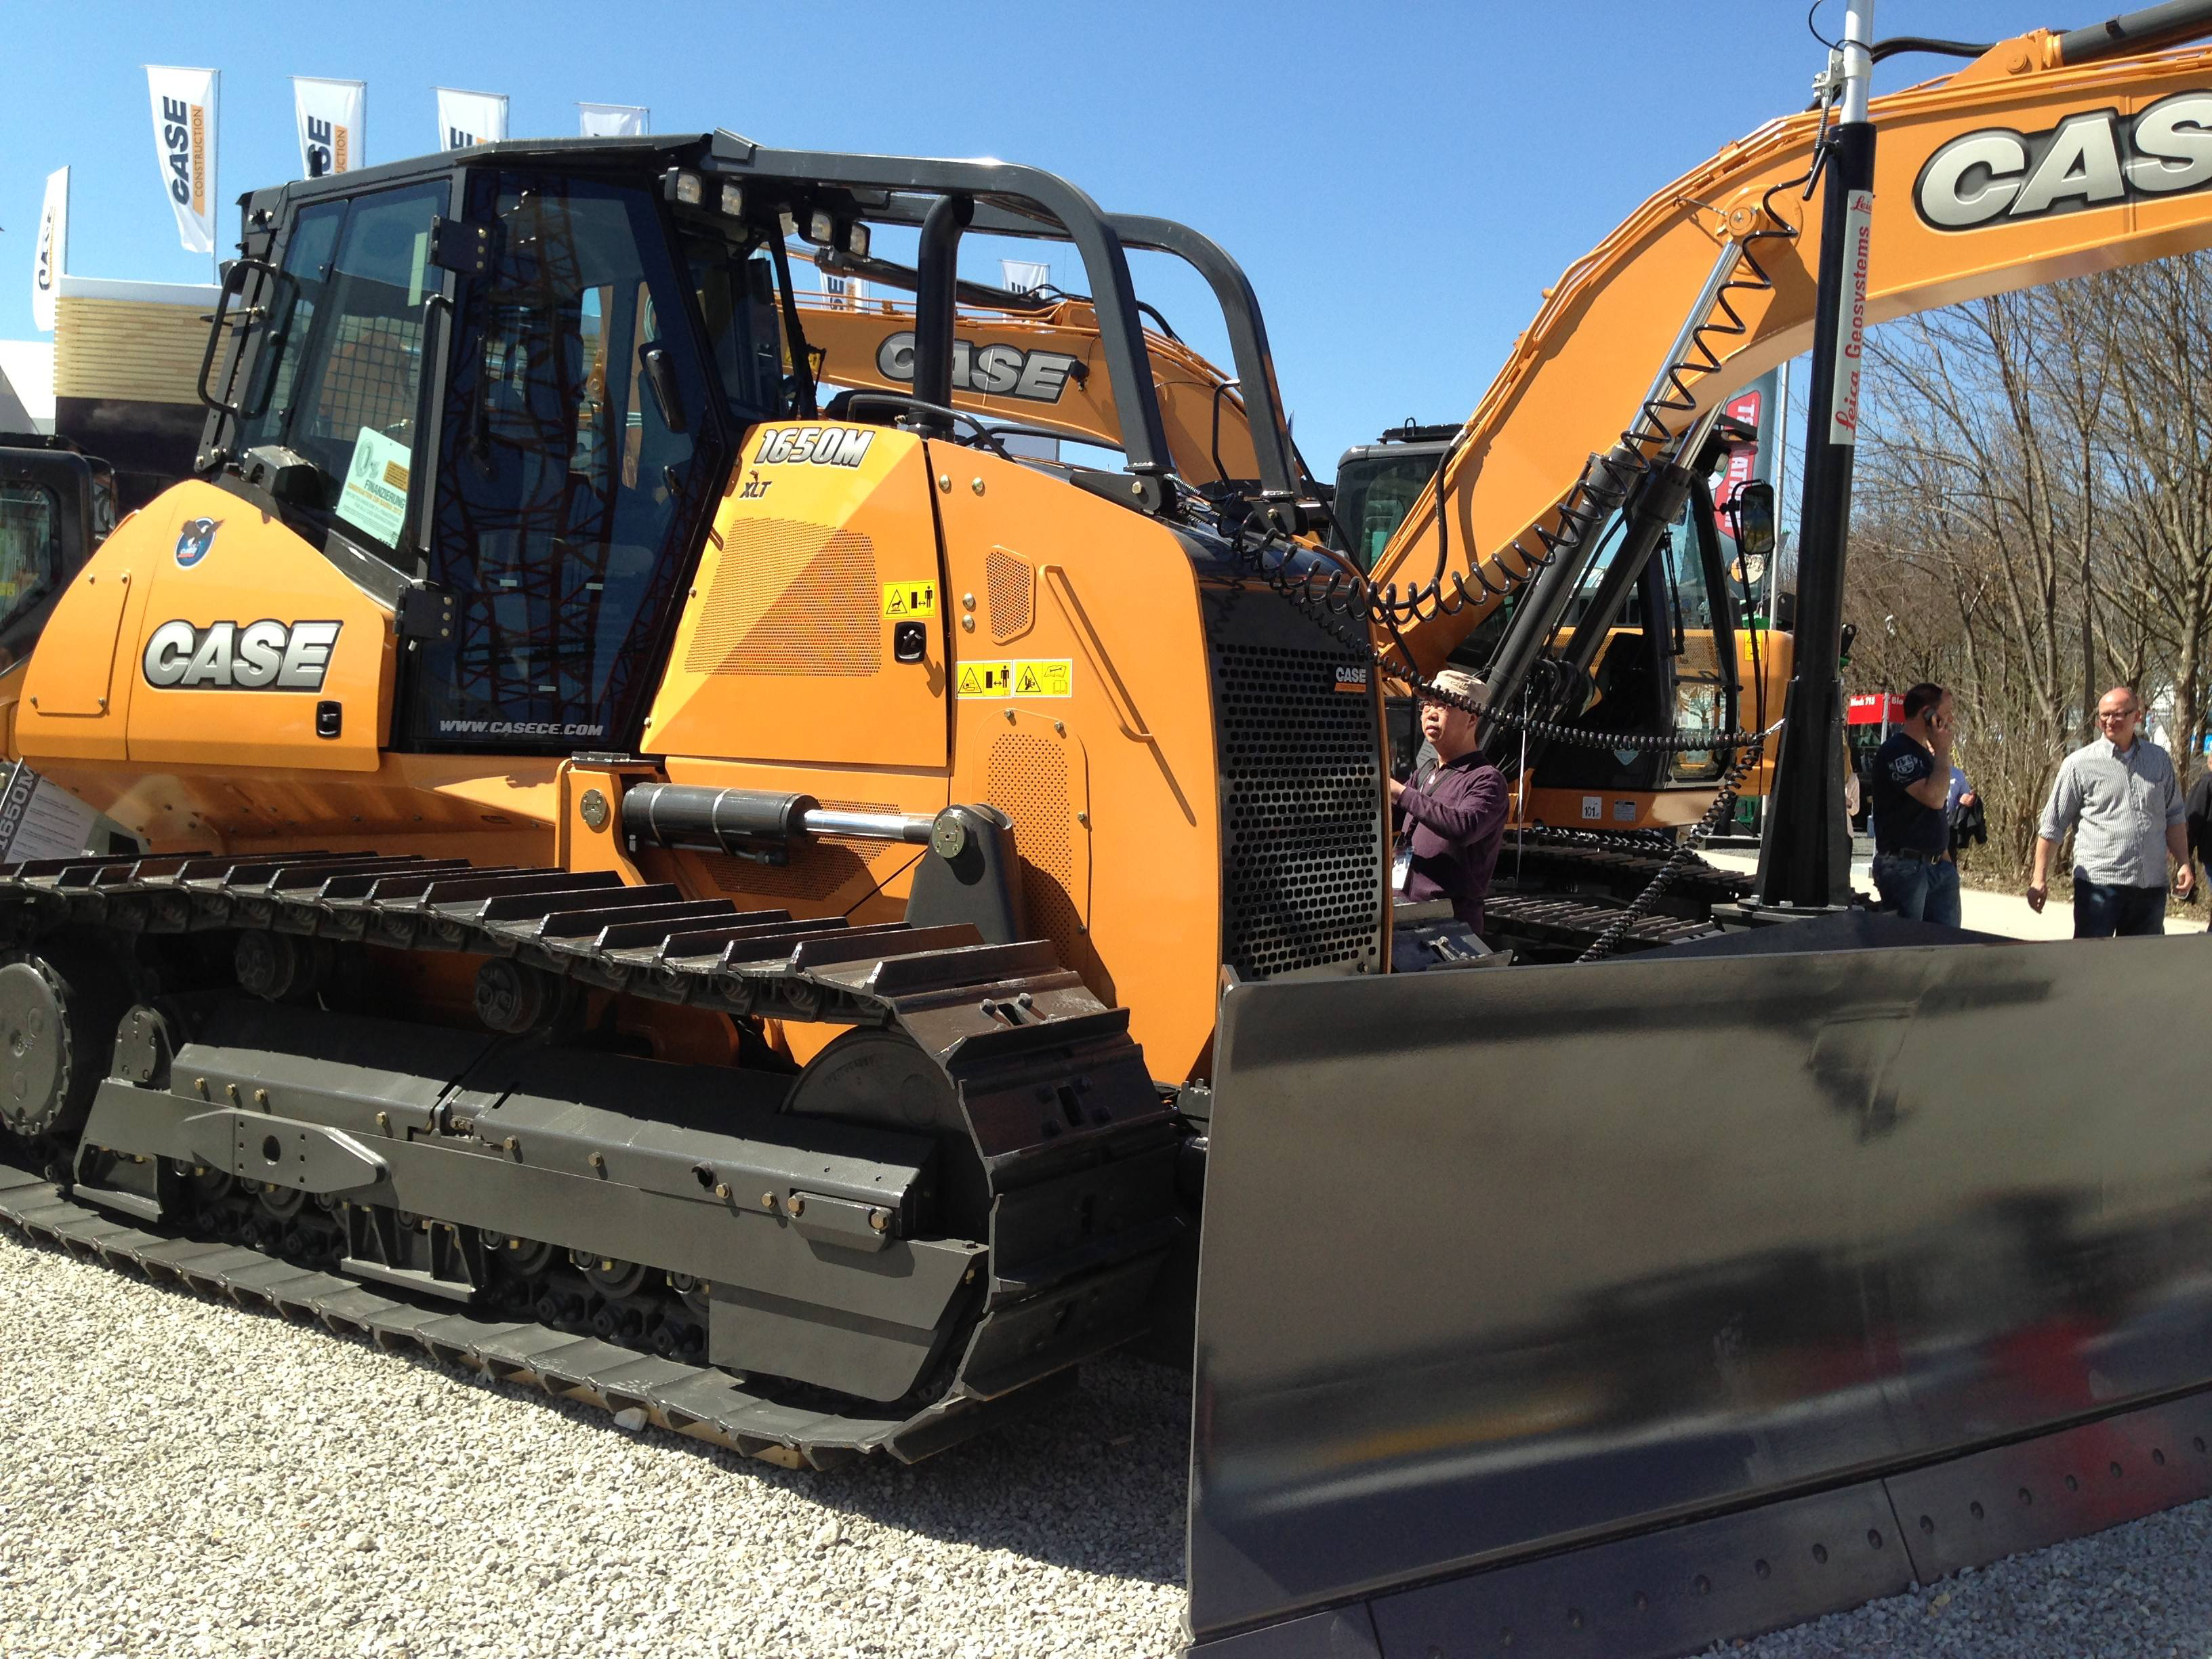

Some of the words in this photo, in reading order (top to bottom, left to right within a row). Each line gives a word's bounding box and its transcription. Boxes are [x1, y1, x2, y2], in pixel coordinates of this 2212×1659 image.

[163, 96, 190, 205] CASE
[192, 108, 203, 197] CONSTRUCTION
[1844, 226, 1869, 359] Geosystems
[1835, 371, 1860, 441] Leica
[754, 427, 876, 468] 1650M
[363, 478, 406, 509] FINANZIERUNG
[739, 481, 772, 498] XLT
[142, 619, 344, 691] CASE
[1336, 667, 1366, 683] CASE
[1891, 696, 1904, 705] Blo
[440, 720, 603, 736] WWW.CASECE.COM
